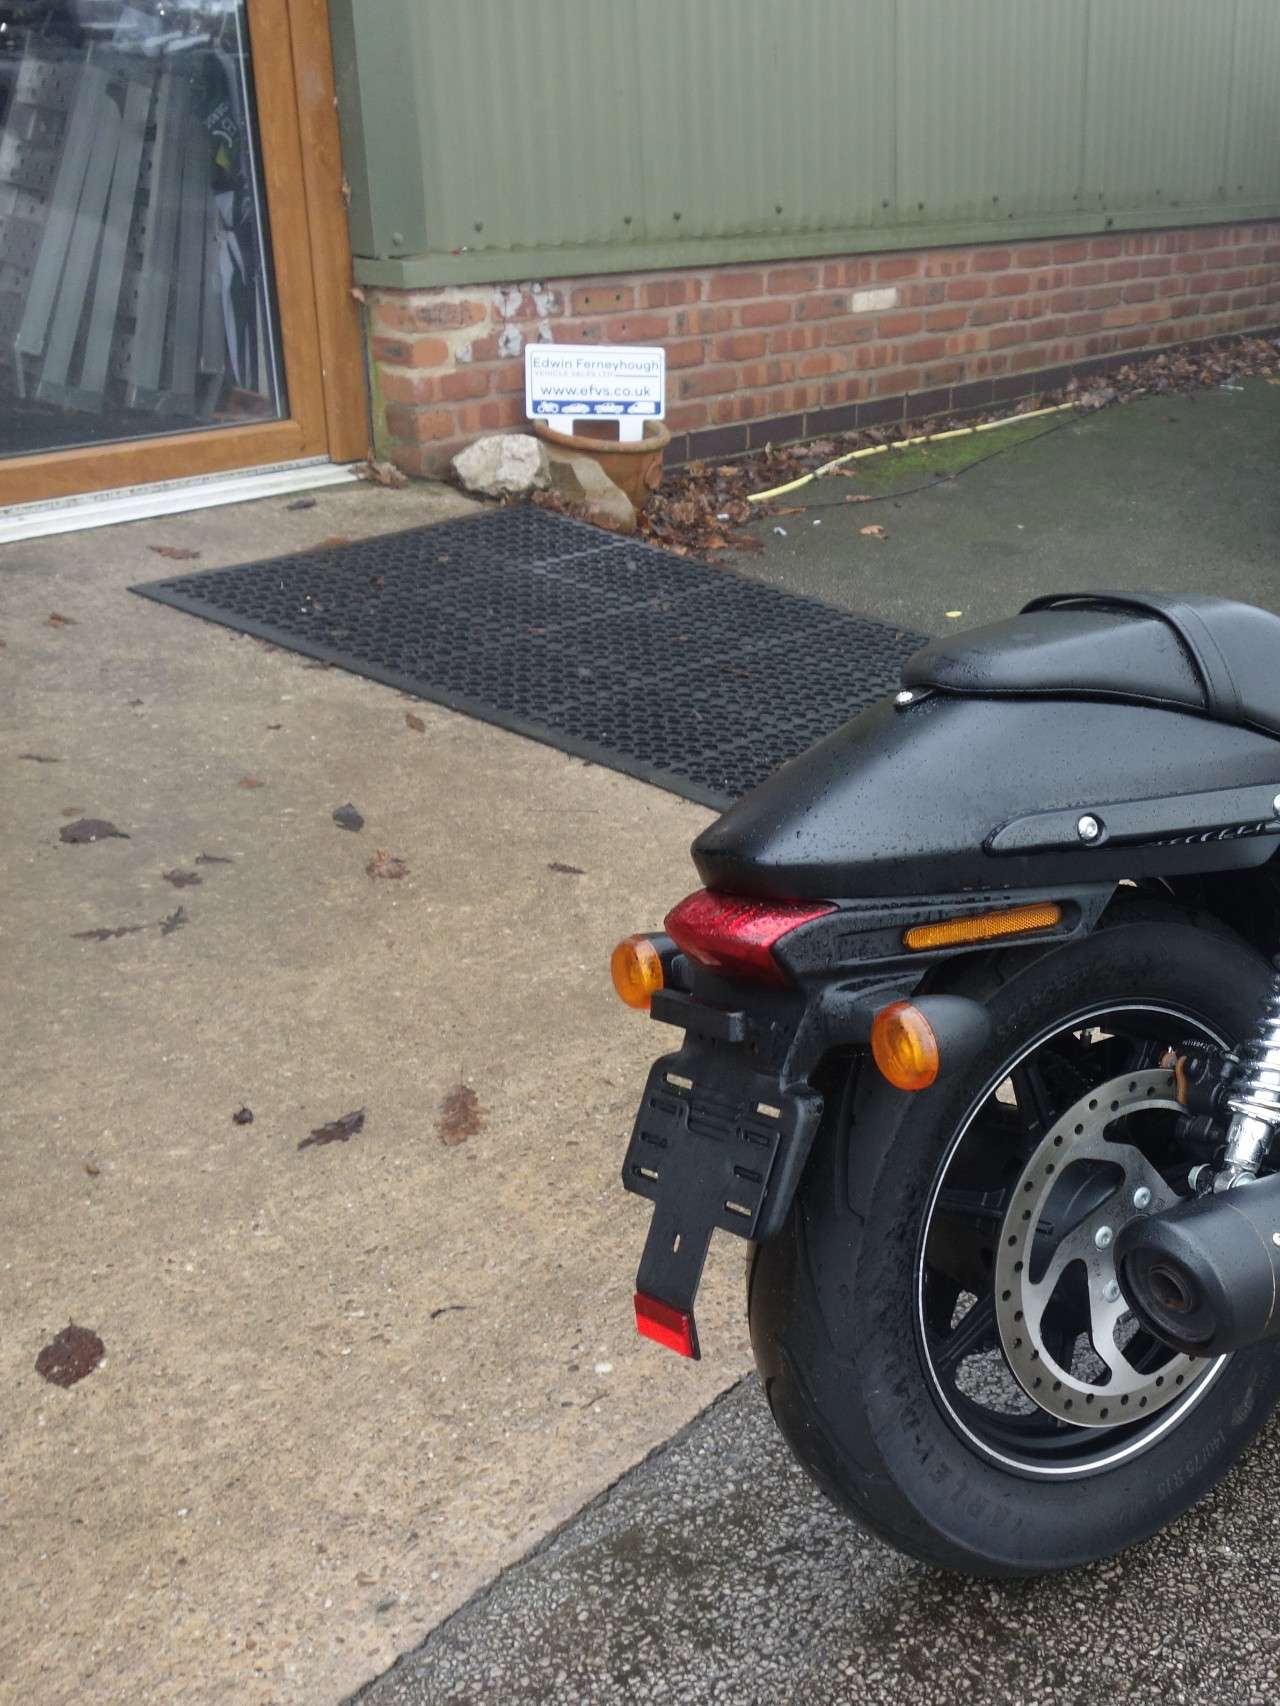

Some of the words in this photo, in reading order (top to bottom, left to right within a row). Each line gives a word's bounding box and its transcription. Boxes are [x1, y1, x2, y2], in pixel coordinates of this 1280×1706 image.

[533, 357, 572, 369] Edwin
[576, 358, 659, 372] Ferneyhough
[540, 384, 651, 397] www.efvs.co.uk
